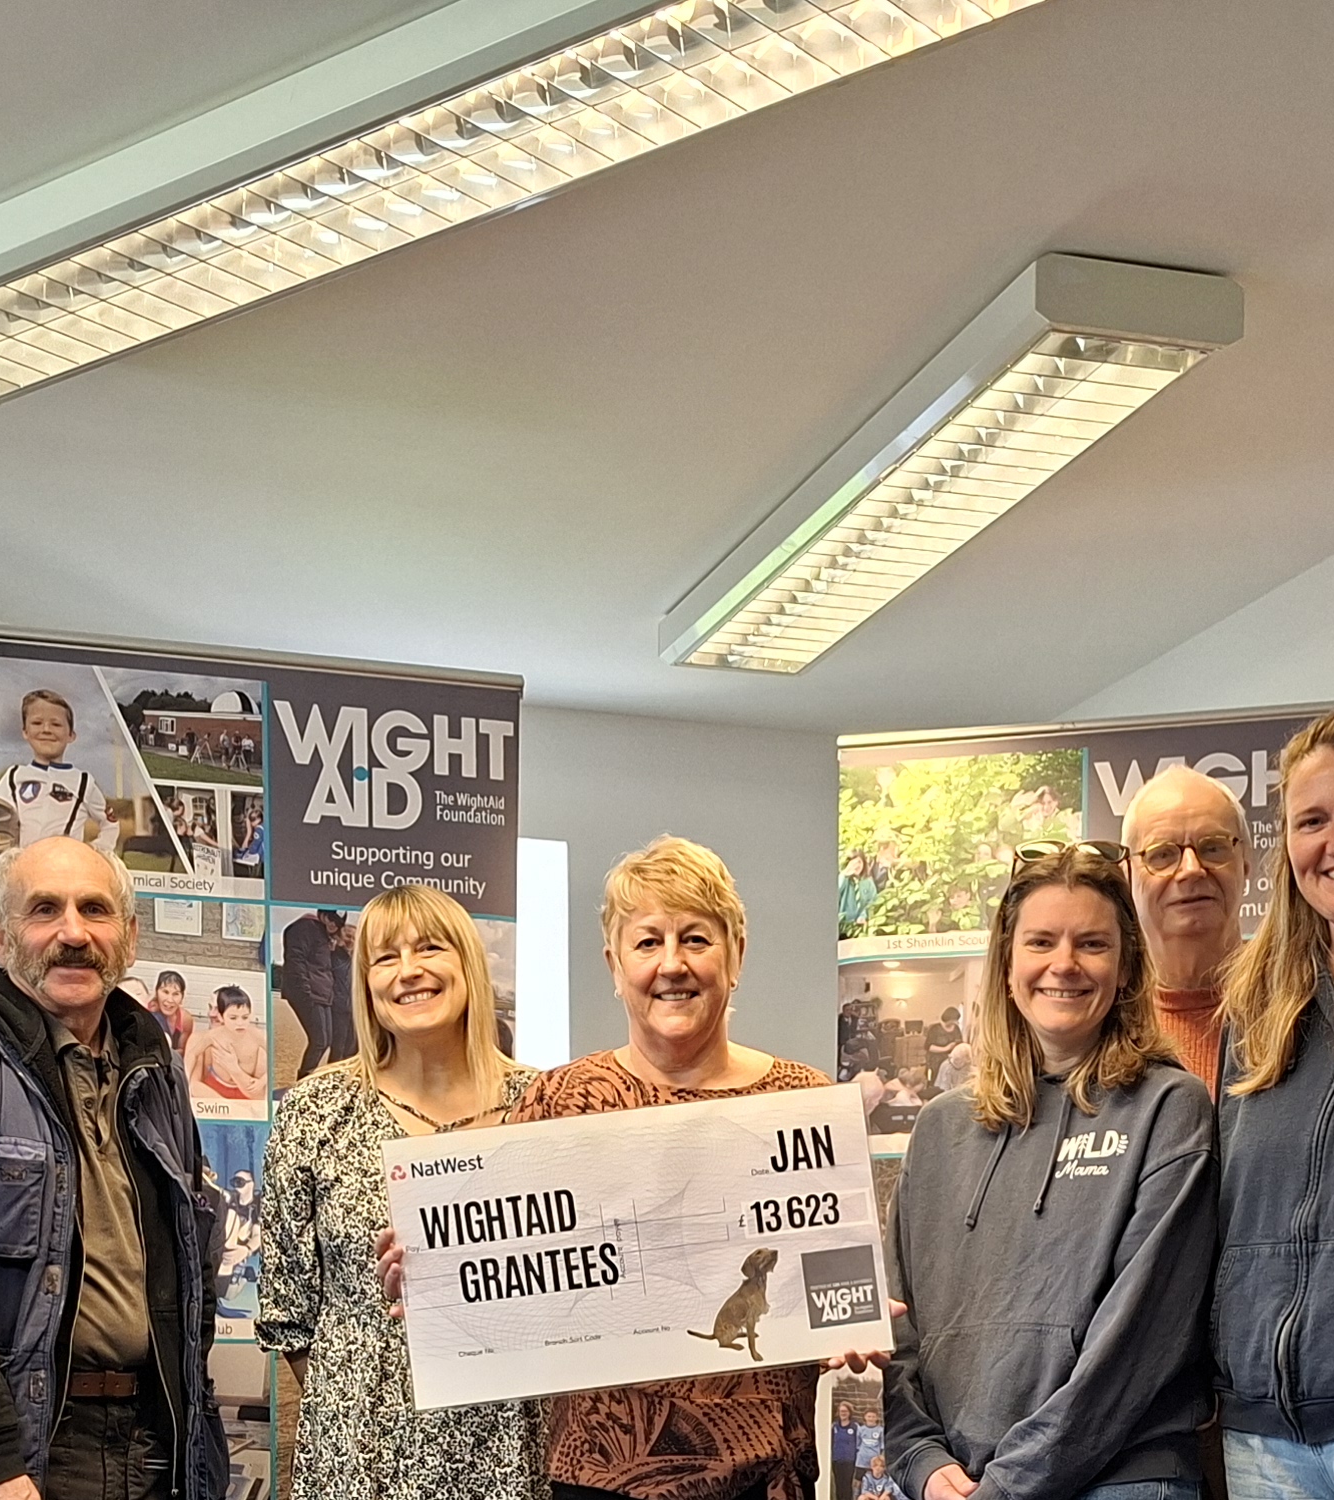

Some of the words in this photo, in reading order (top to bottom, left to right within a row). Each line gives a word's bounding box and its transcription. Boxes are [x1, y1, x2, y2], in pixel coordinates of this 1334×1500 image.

[272, 700, 514, 781] WIGHT
[435, 790, 455, 806] The
[456, 792, 505, 812] WightAid
[436, 806, 505, 826] Foundation
[1252, 821, 1273, 833] The
[331, 841, 434, 869] Supporting
[440, 852, 472, 868] our
[170, 877, 214, 893] Society
[310, 869, 375, 891] unique
[887, 939, 901, 949] 1st
[907, 937, 954, 949] Shanklin
[196, 1102, 229, 1114] Swim
[770, 1125, 835, 1172] JAN
[410, 1154, 484, 1178] NatWest
[1055, 1160, 1109, 1179] Mama
[419, 1189, 577, 1249] WIGHTAID
[459, 1242, 619, 1303] GRANTEES
[810, 1284, 873, 1308] WIGHT
